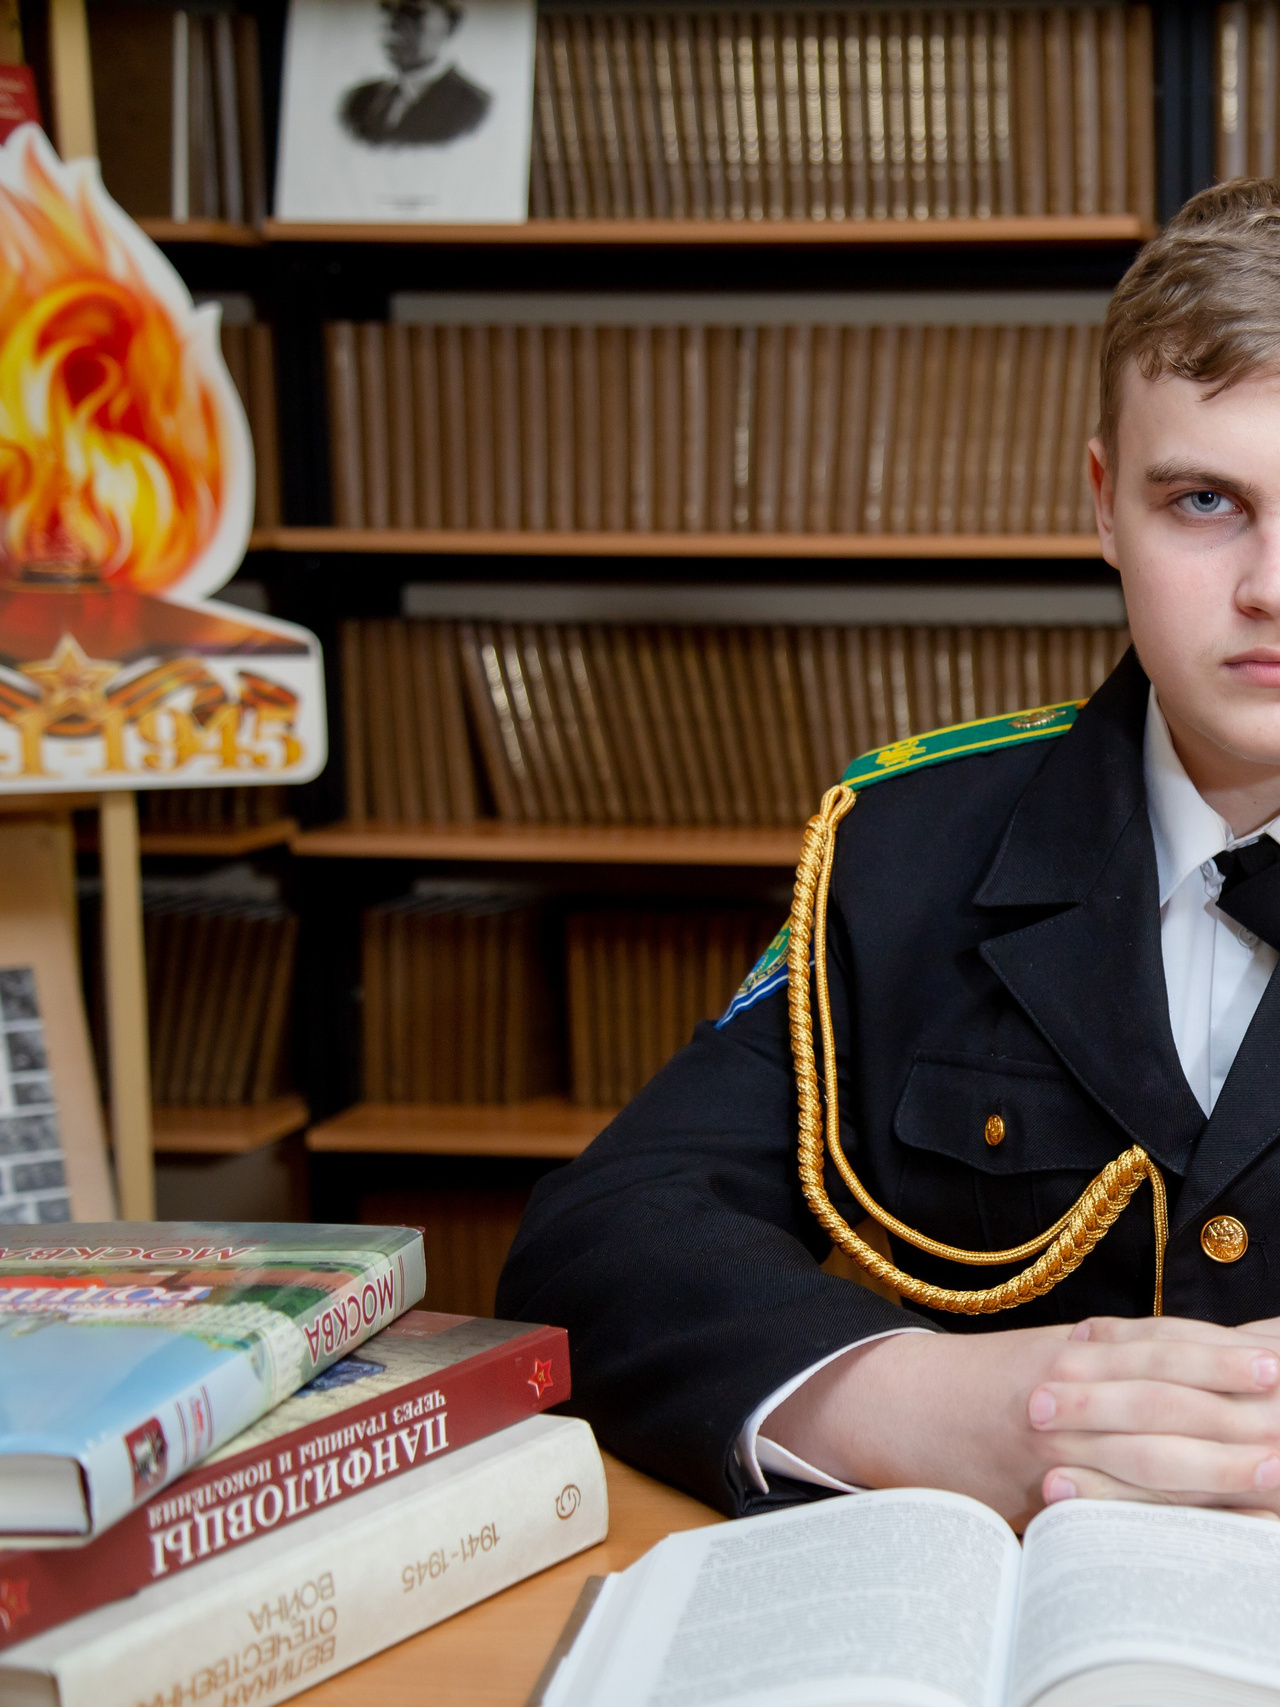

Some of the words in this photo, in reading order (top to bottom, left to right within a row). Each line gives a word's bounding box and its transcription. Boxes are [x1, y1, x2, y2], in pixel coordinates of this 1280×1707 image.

[0, 1246, 257, 1263] МОСКВА
[304, 1267, 396, 1366] МОСКВА
[299, 1404, 387, 1466] ГРАНИЦЫ
[391, 1389, 447, 1426] ЧЕРЕЗ
[278, 1442, 292, 1467] И
[148, 1460, 273, 1528] ПОКОЛЕНИЯ
[150, 1411, 450, 1578] ПАНФИЛОВЦЫ
[401, 1522, 501, 1594] 1941-1945
[248, 1570, 335, 1634] ВОЙНА
